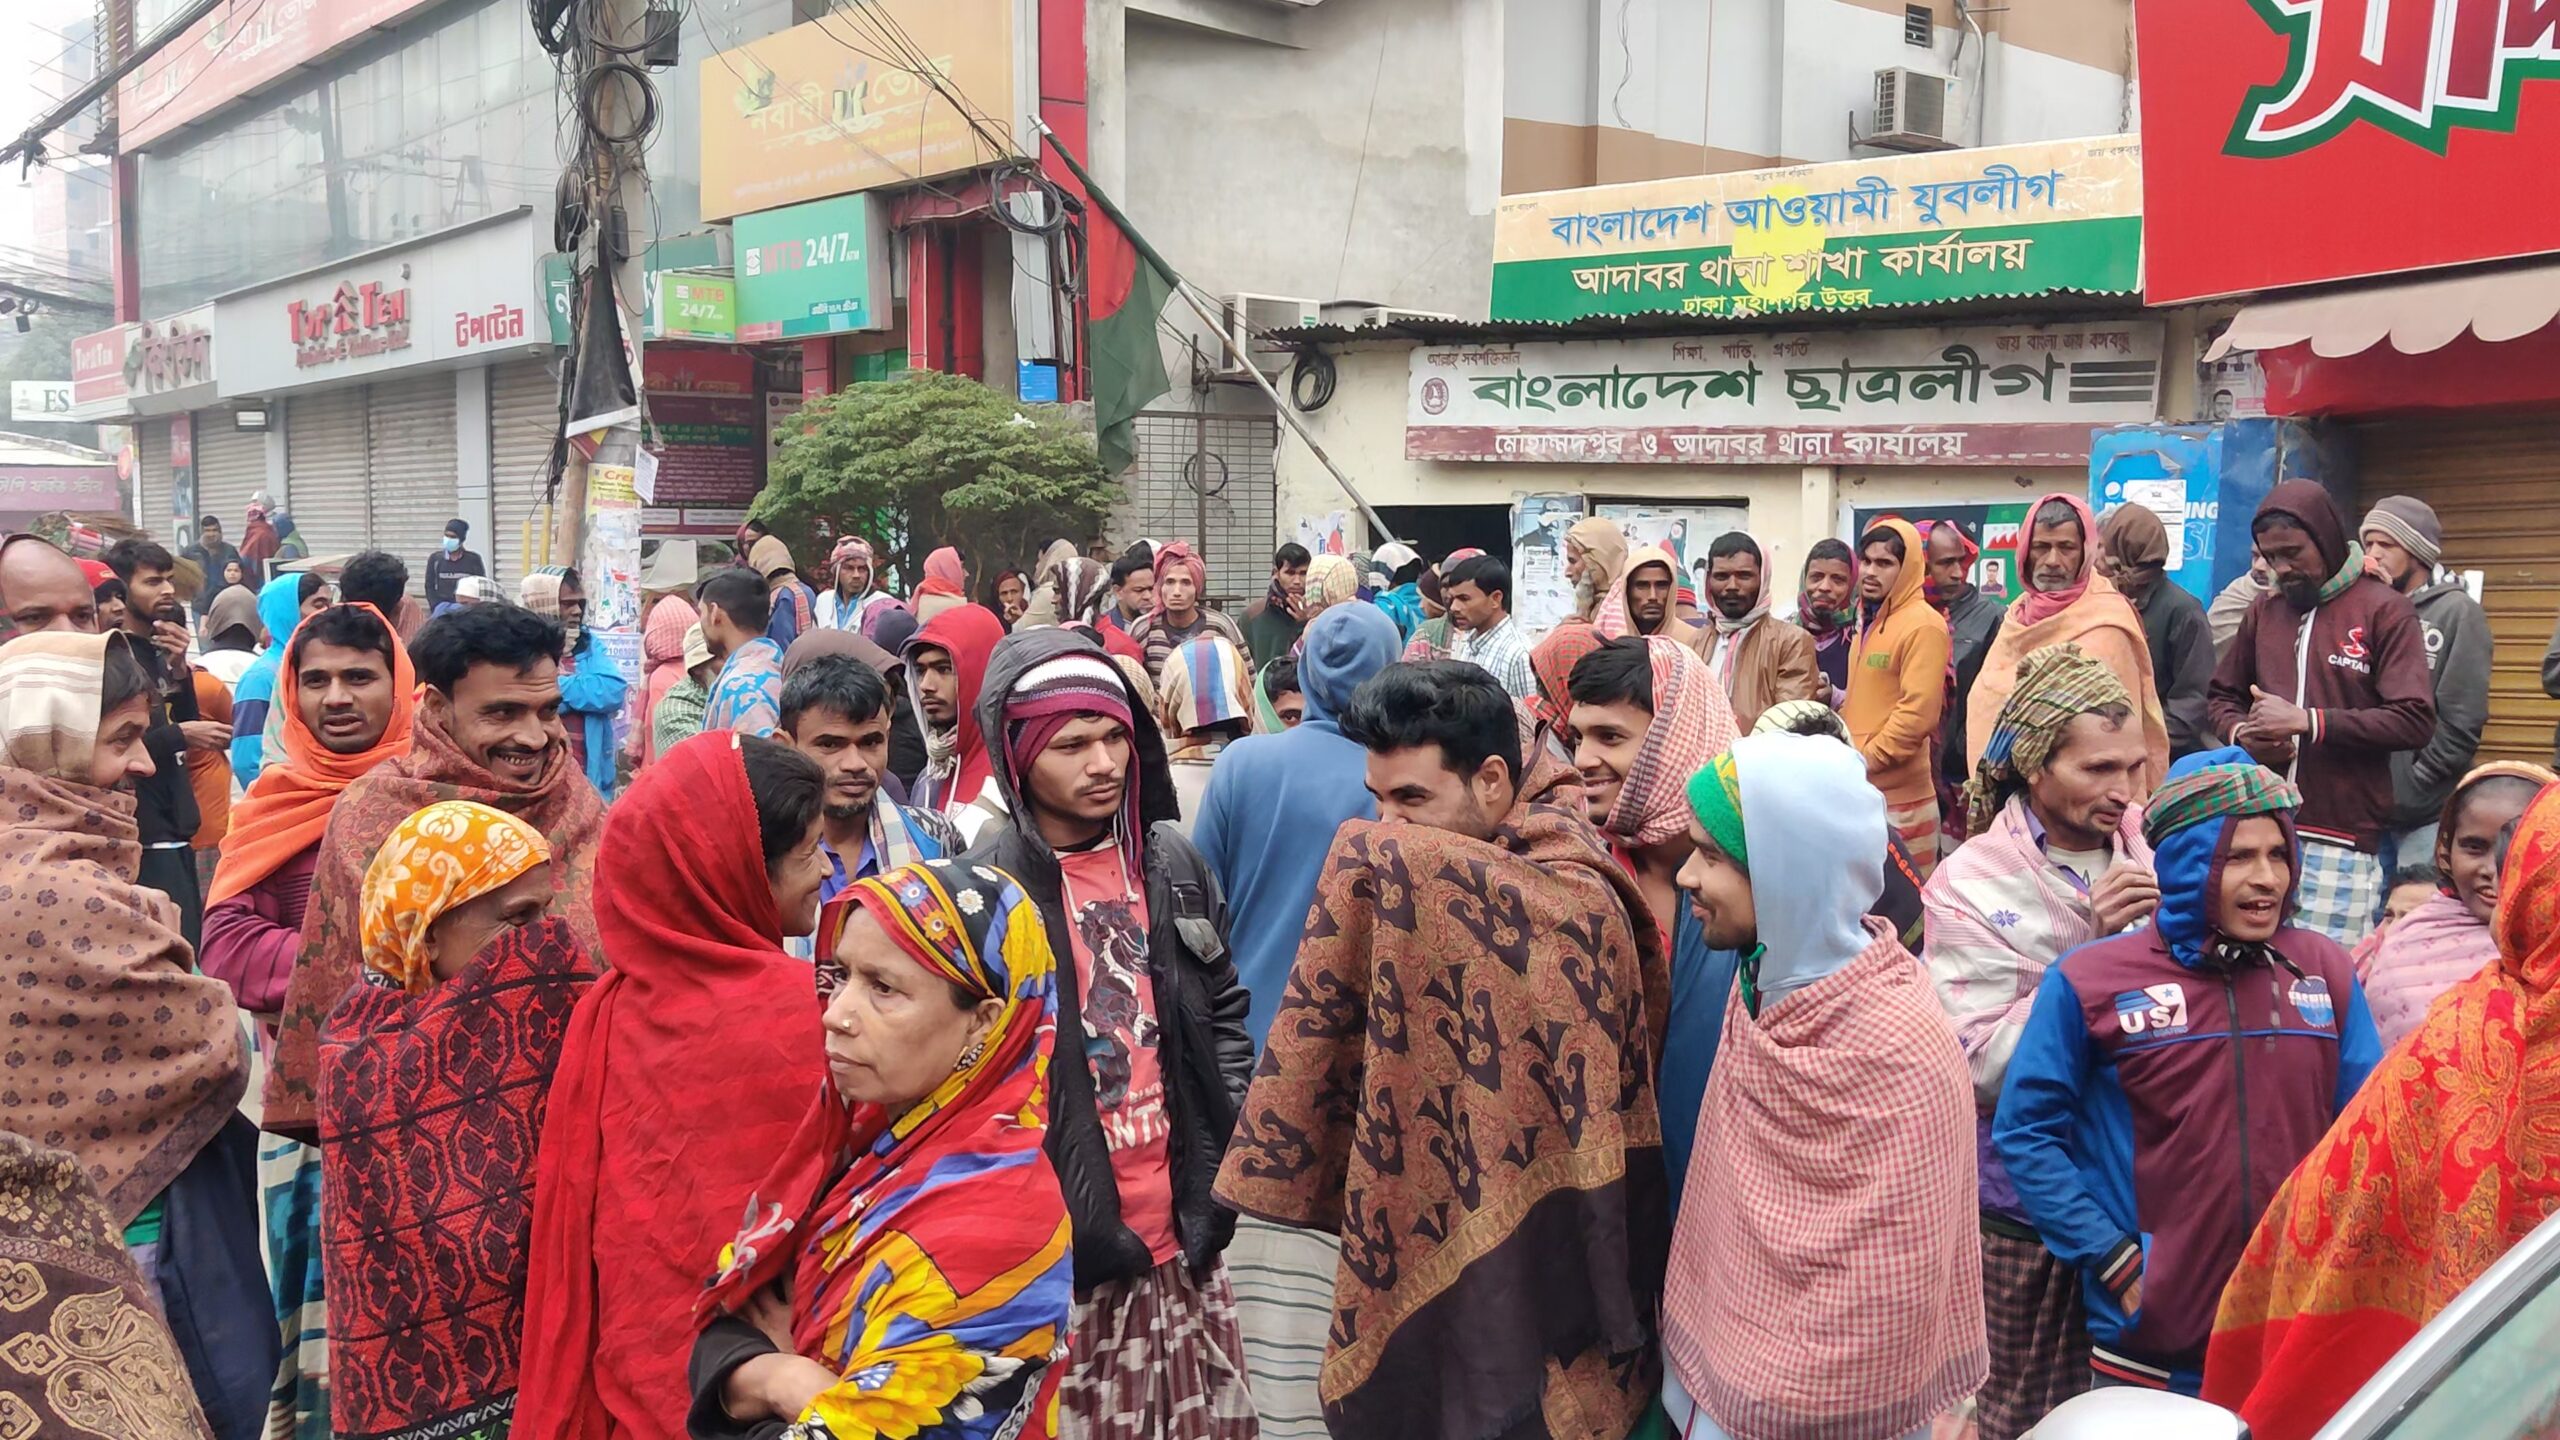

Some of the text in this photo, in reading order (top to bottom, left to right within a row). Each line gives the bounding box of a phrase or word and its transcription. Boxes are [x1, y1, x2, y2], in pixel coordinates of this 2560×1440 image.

[1550, 164, 2064, 246] বাংলাদেশ আওয়ামী যুবলীগ
[763, 240, 803, 273] MTB
[805, 232, 849, 268] 24/7
[1571, 232, 2033, 295] আদাবর থানা শাখা কার্যালয়
[691, 286, 725, 301] MTB
[1682, 286, 1872, 314] ঢাকা মহানগর উত্তর
[455, 304, 524, 347] টপটেন
[679, 303, 715, 319] 24/7
[1773, 337, 1810, 359] প্রগতি
[1995, 335, 2021, 352] জয়
[2027, 334, 2058, 351] বাংলা
[2062, 333, 2083, 350] জয়
[1468, 343, 2064, 413] বাংলাদেশ ছাত্রলীগ
[1495, 426, 1968, 460] মোহাম্মদপুর ও আদাবর থানা কার্যালয়
